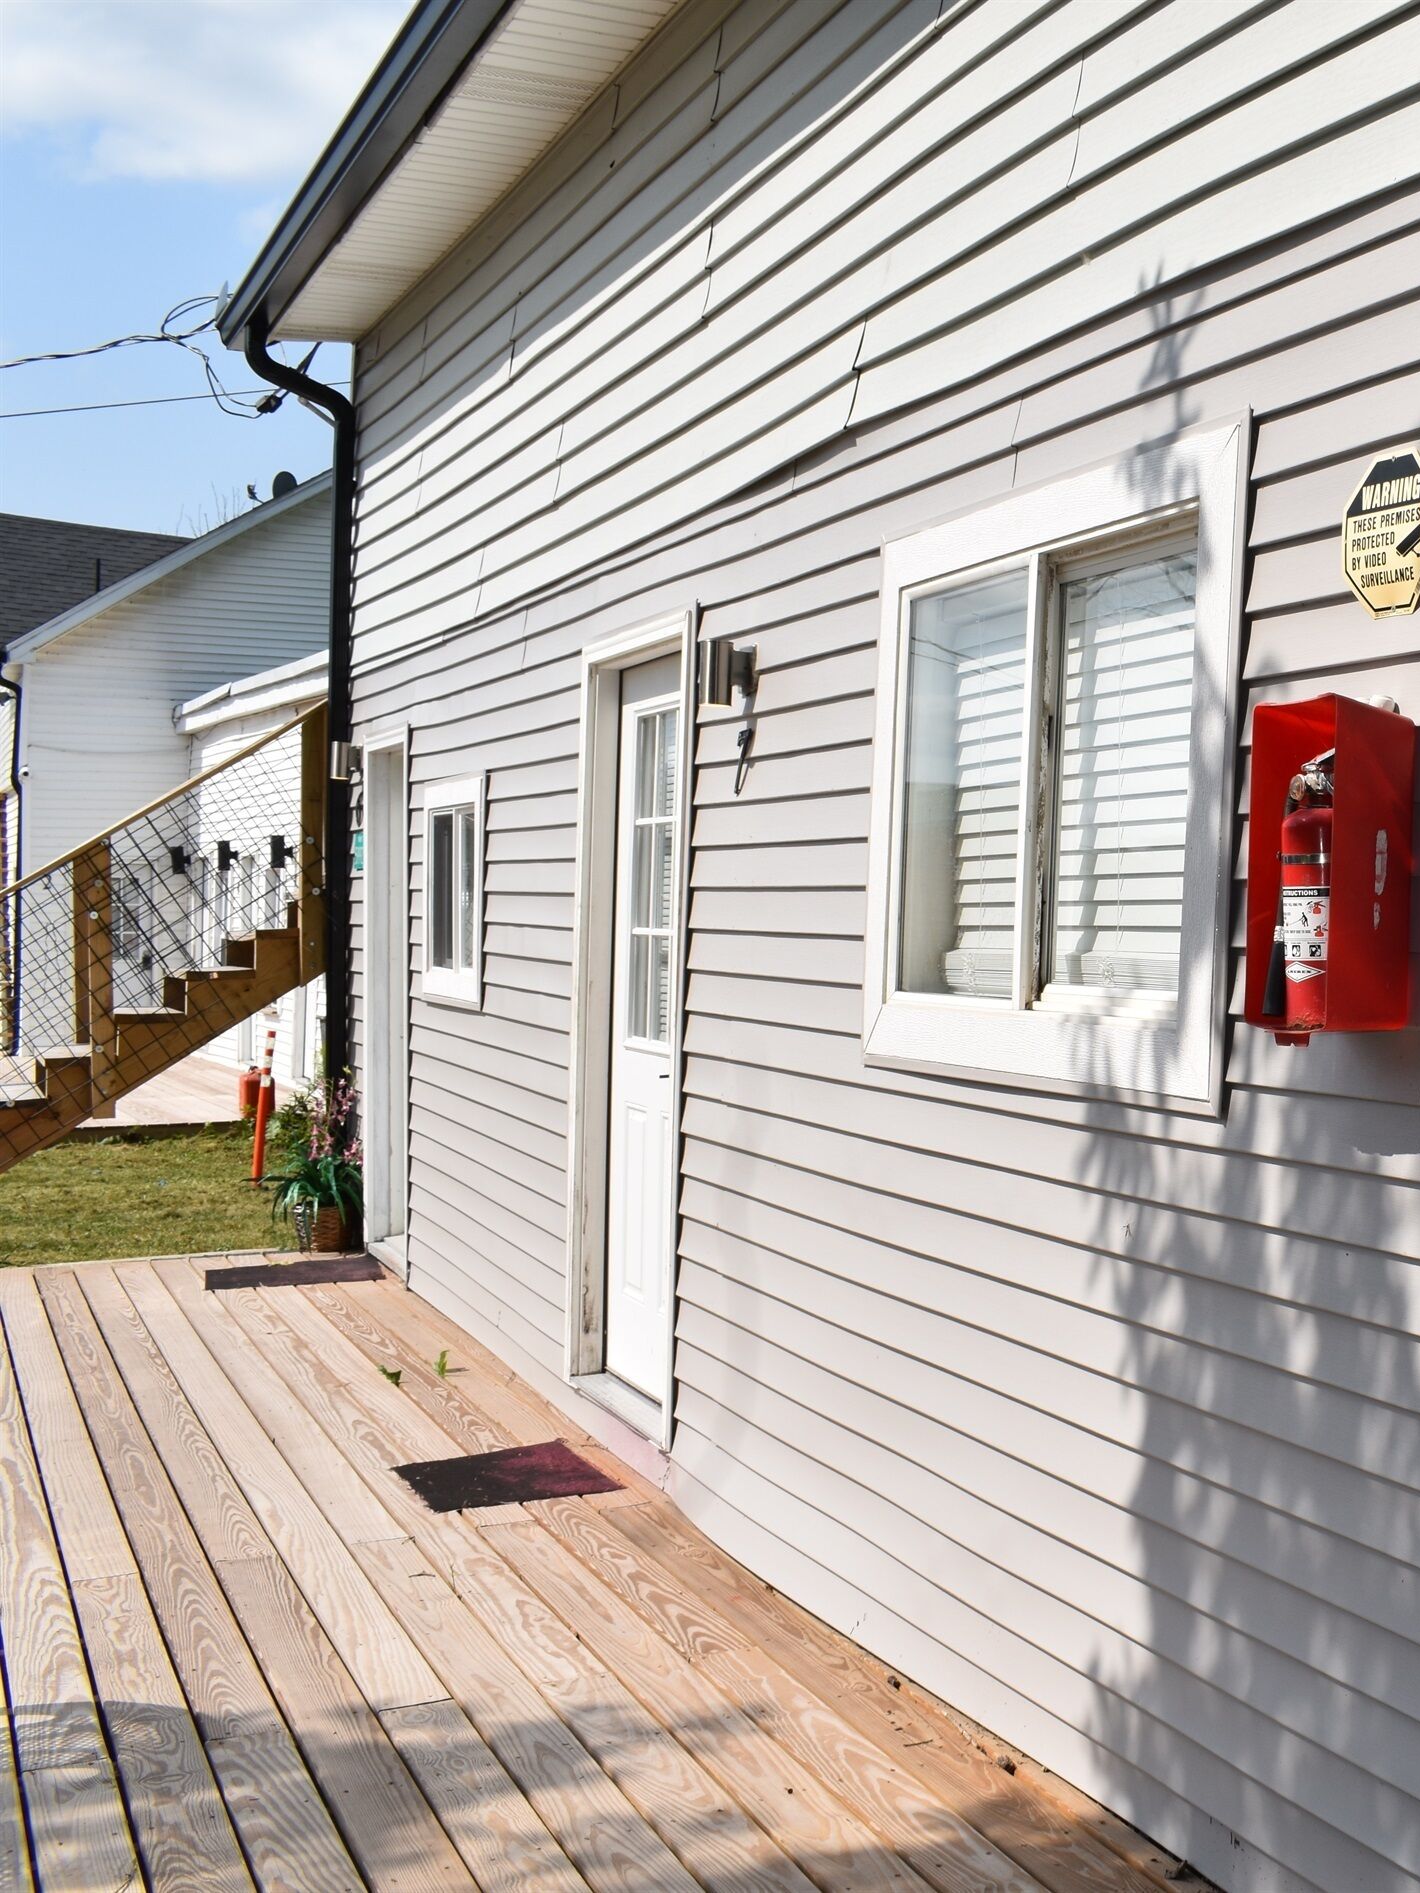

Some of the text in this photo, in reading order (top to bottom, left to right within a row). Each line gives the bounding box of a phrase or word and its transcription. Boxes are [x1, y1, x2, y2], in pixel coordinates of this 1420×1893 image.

[1353, 507, 1420, 534] THESE PREMISES
[1352, 531, 1395, 552] PROTECTED
[1352, 551, 1387, 571] BY VIDEO
[1360, 566, 1414, 589] SURVEILLANCE
